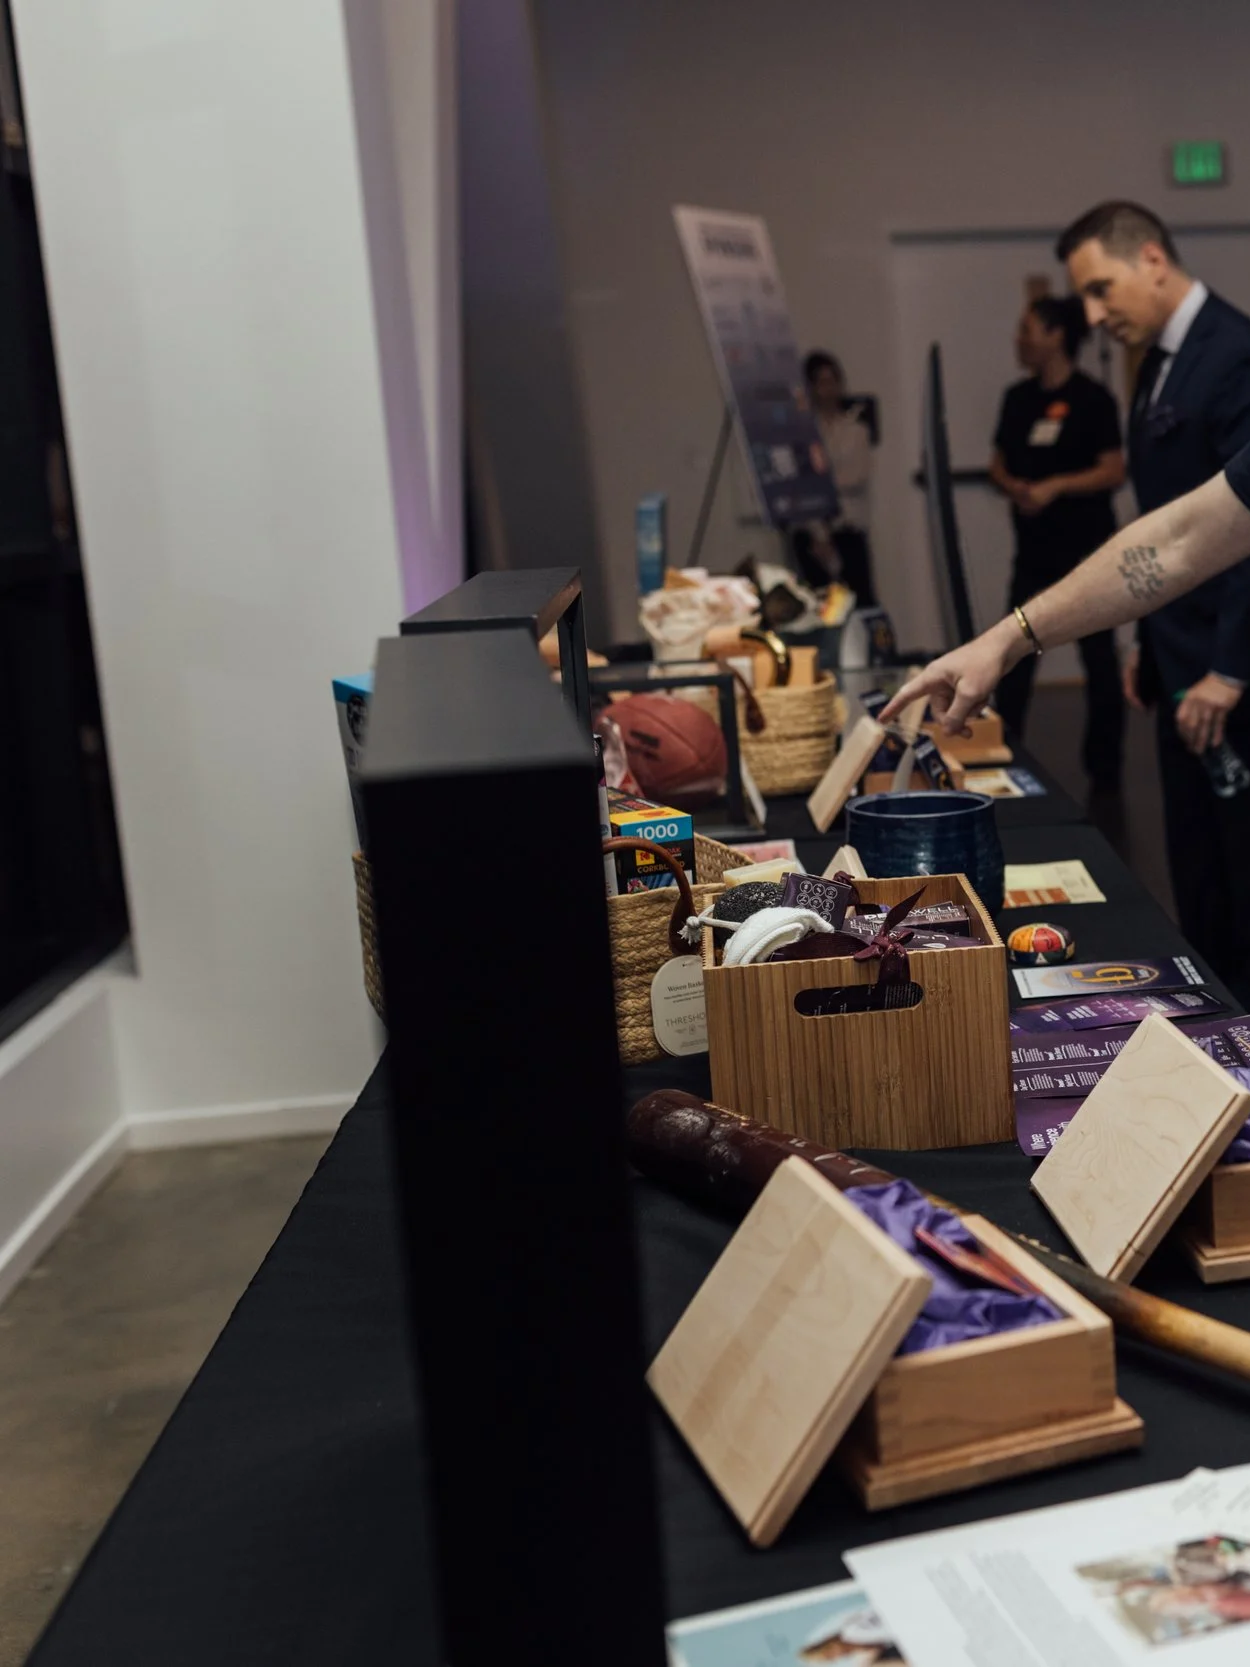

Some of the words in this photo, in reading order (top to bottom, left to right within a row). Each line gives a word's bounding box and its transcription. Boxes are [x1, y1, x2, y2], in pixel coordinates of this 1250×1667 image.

[637, 823, 678, 840] 1000
[667, 983, 687, 992] Woven
[666, 1013, 705, 1027] THRESHO
[1031, 1133, 1046, 1150] Where
